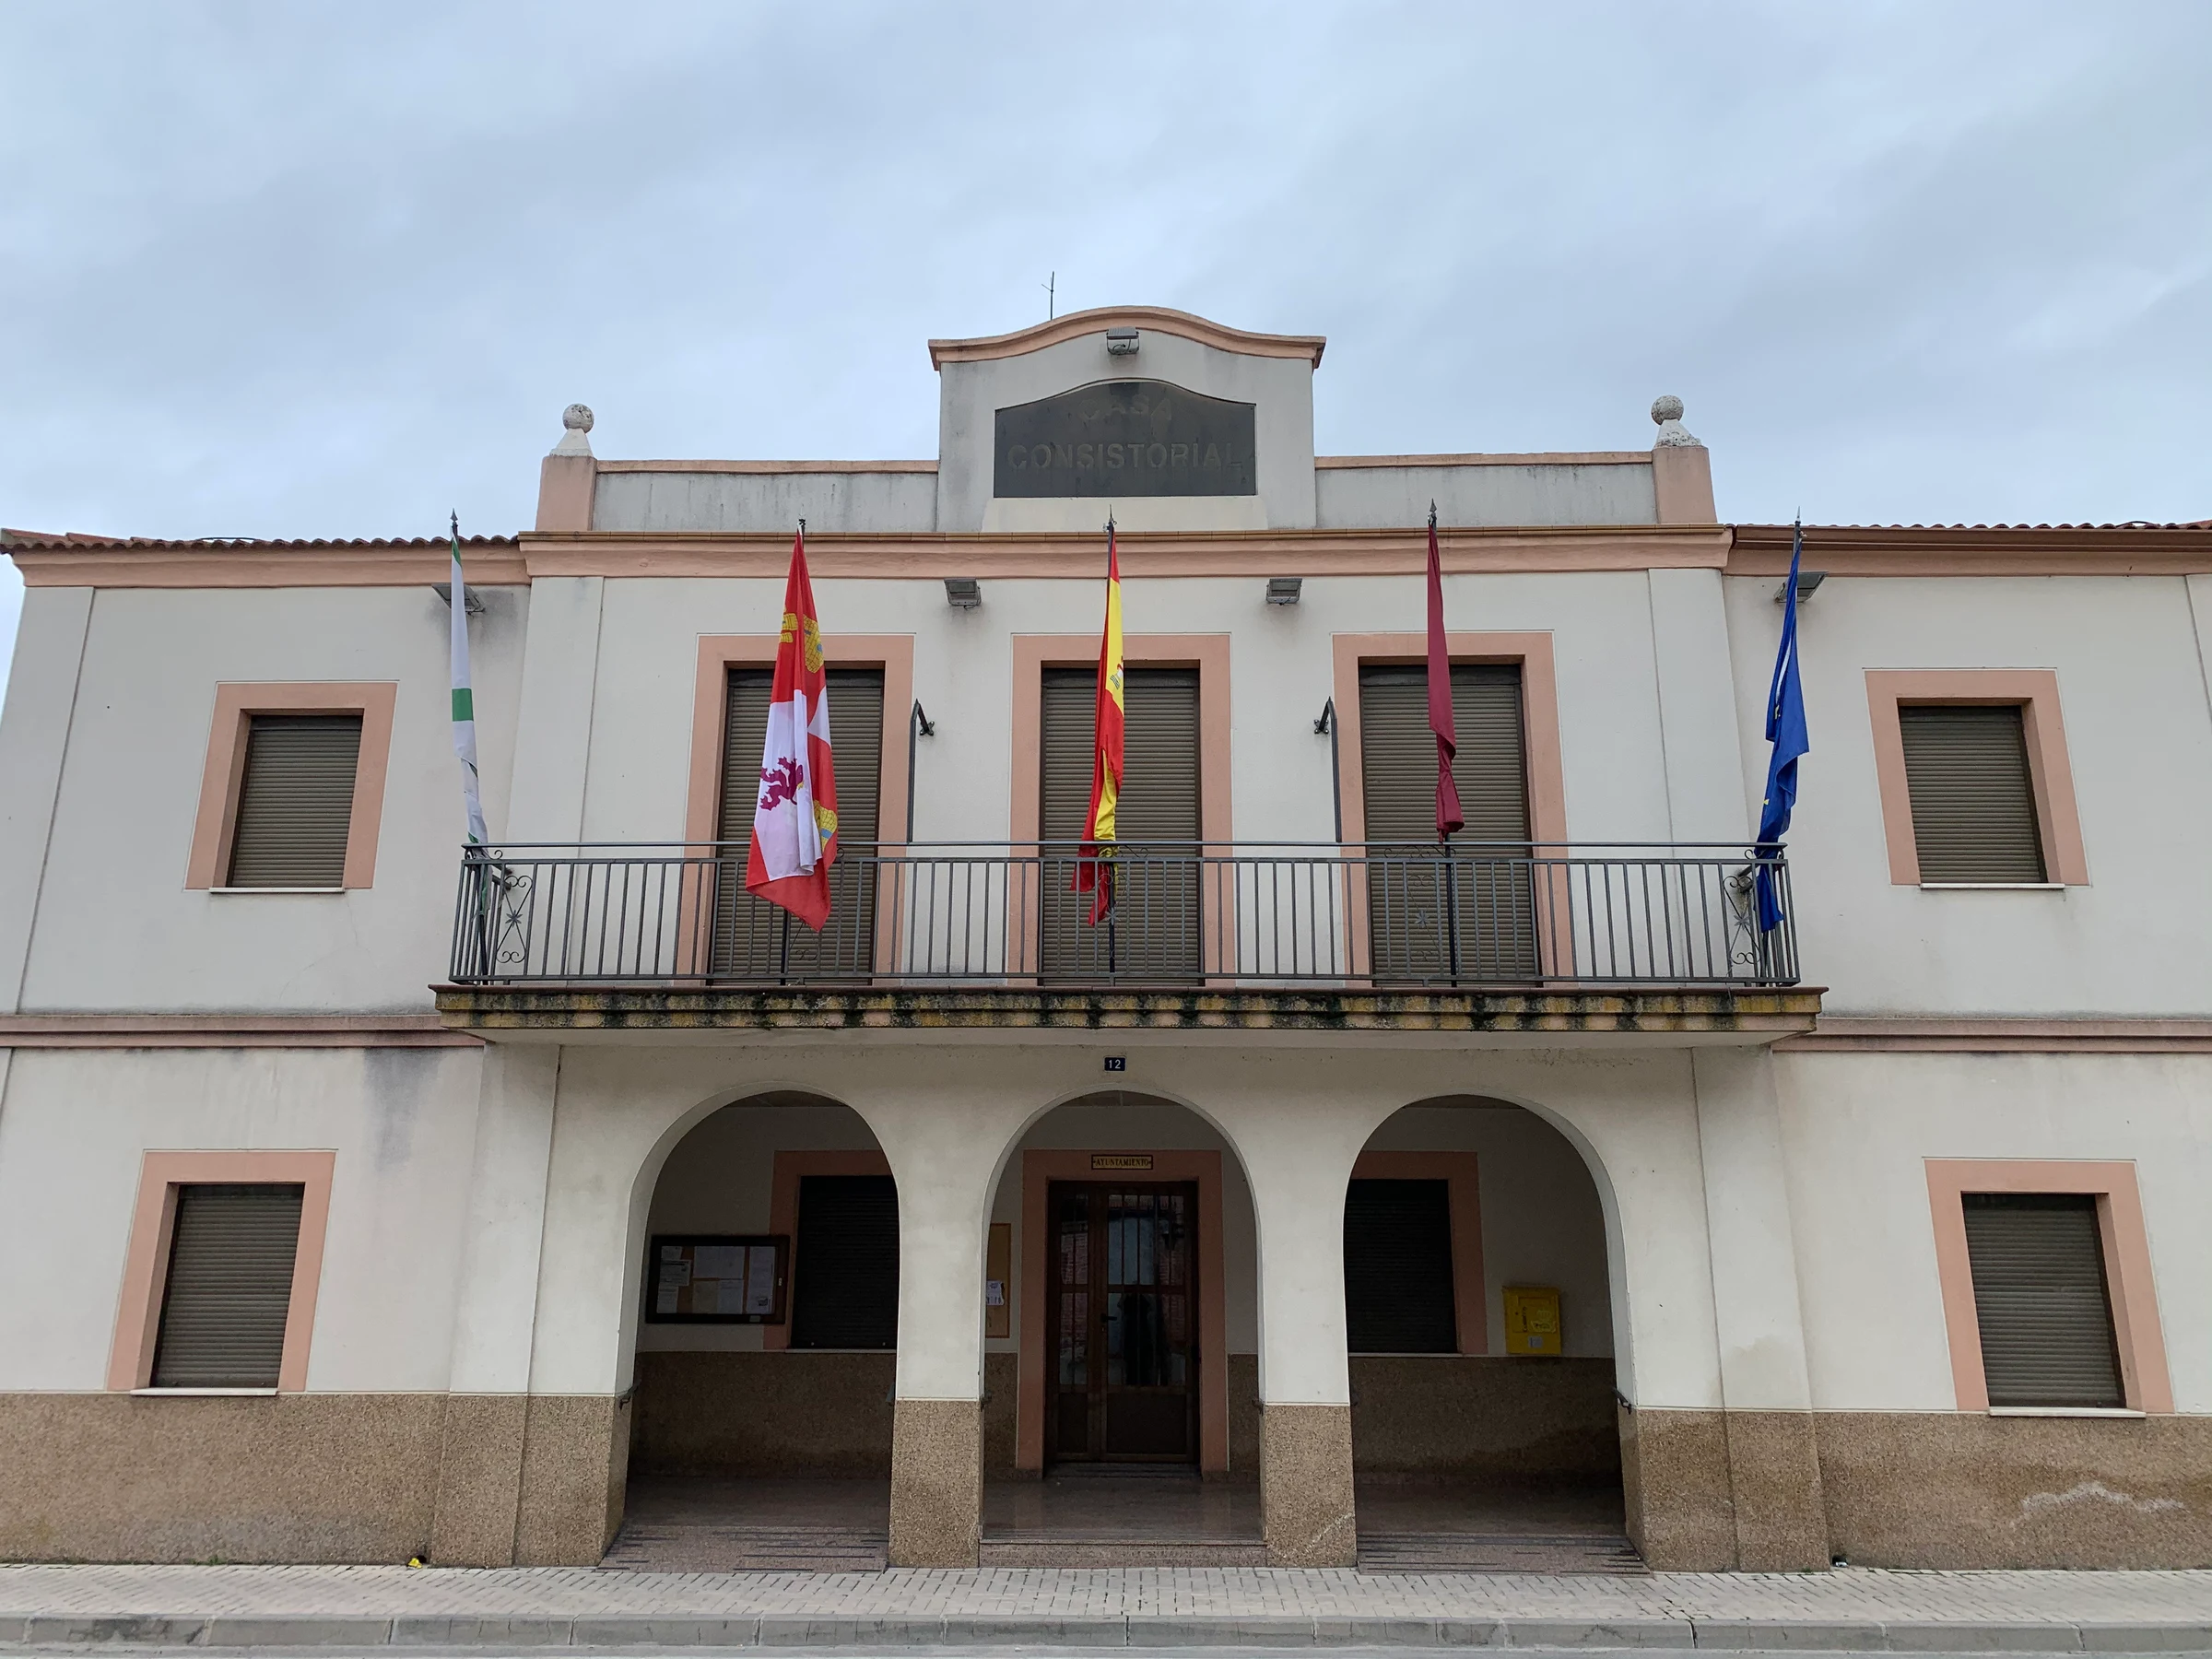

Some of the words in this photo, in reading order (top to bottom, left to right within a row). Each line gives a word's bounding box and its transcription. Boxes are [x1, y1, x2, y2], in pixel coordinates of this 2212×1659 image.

[1007, 441, 1242, 469] CONSISTORIAL
[1109, 1059, 1121, 1069] 12
[1096, 1158, 1149, 1166] AYUNTAMIENTO
